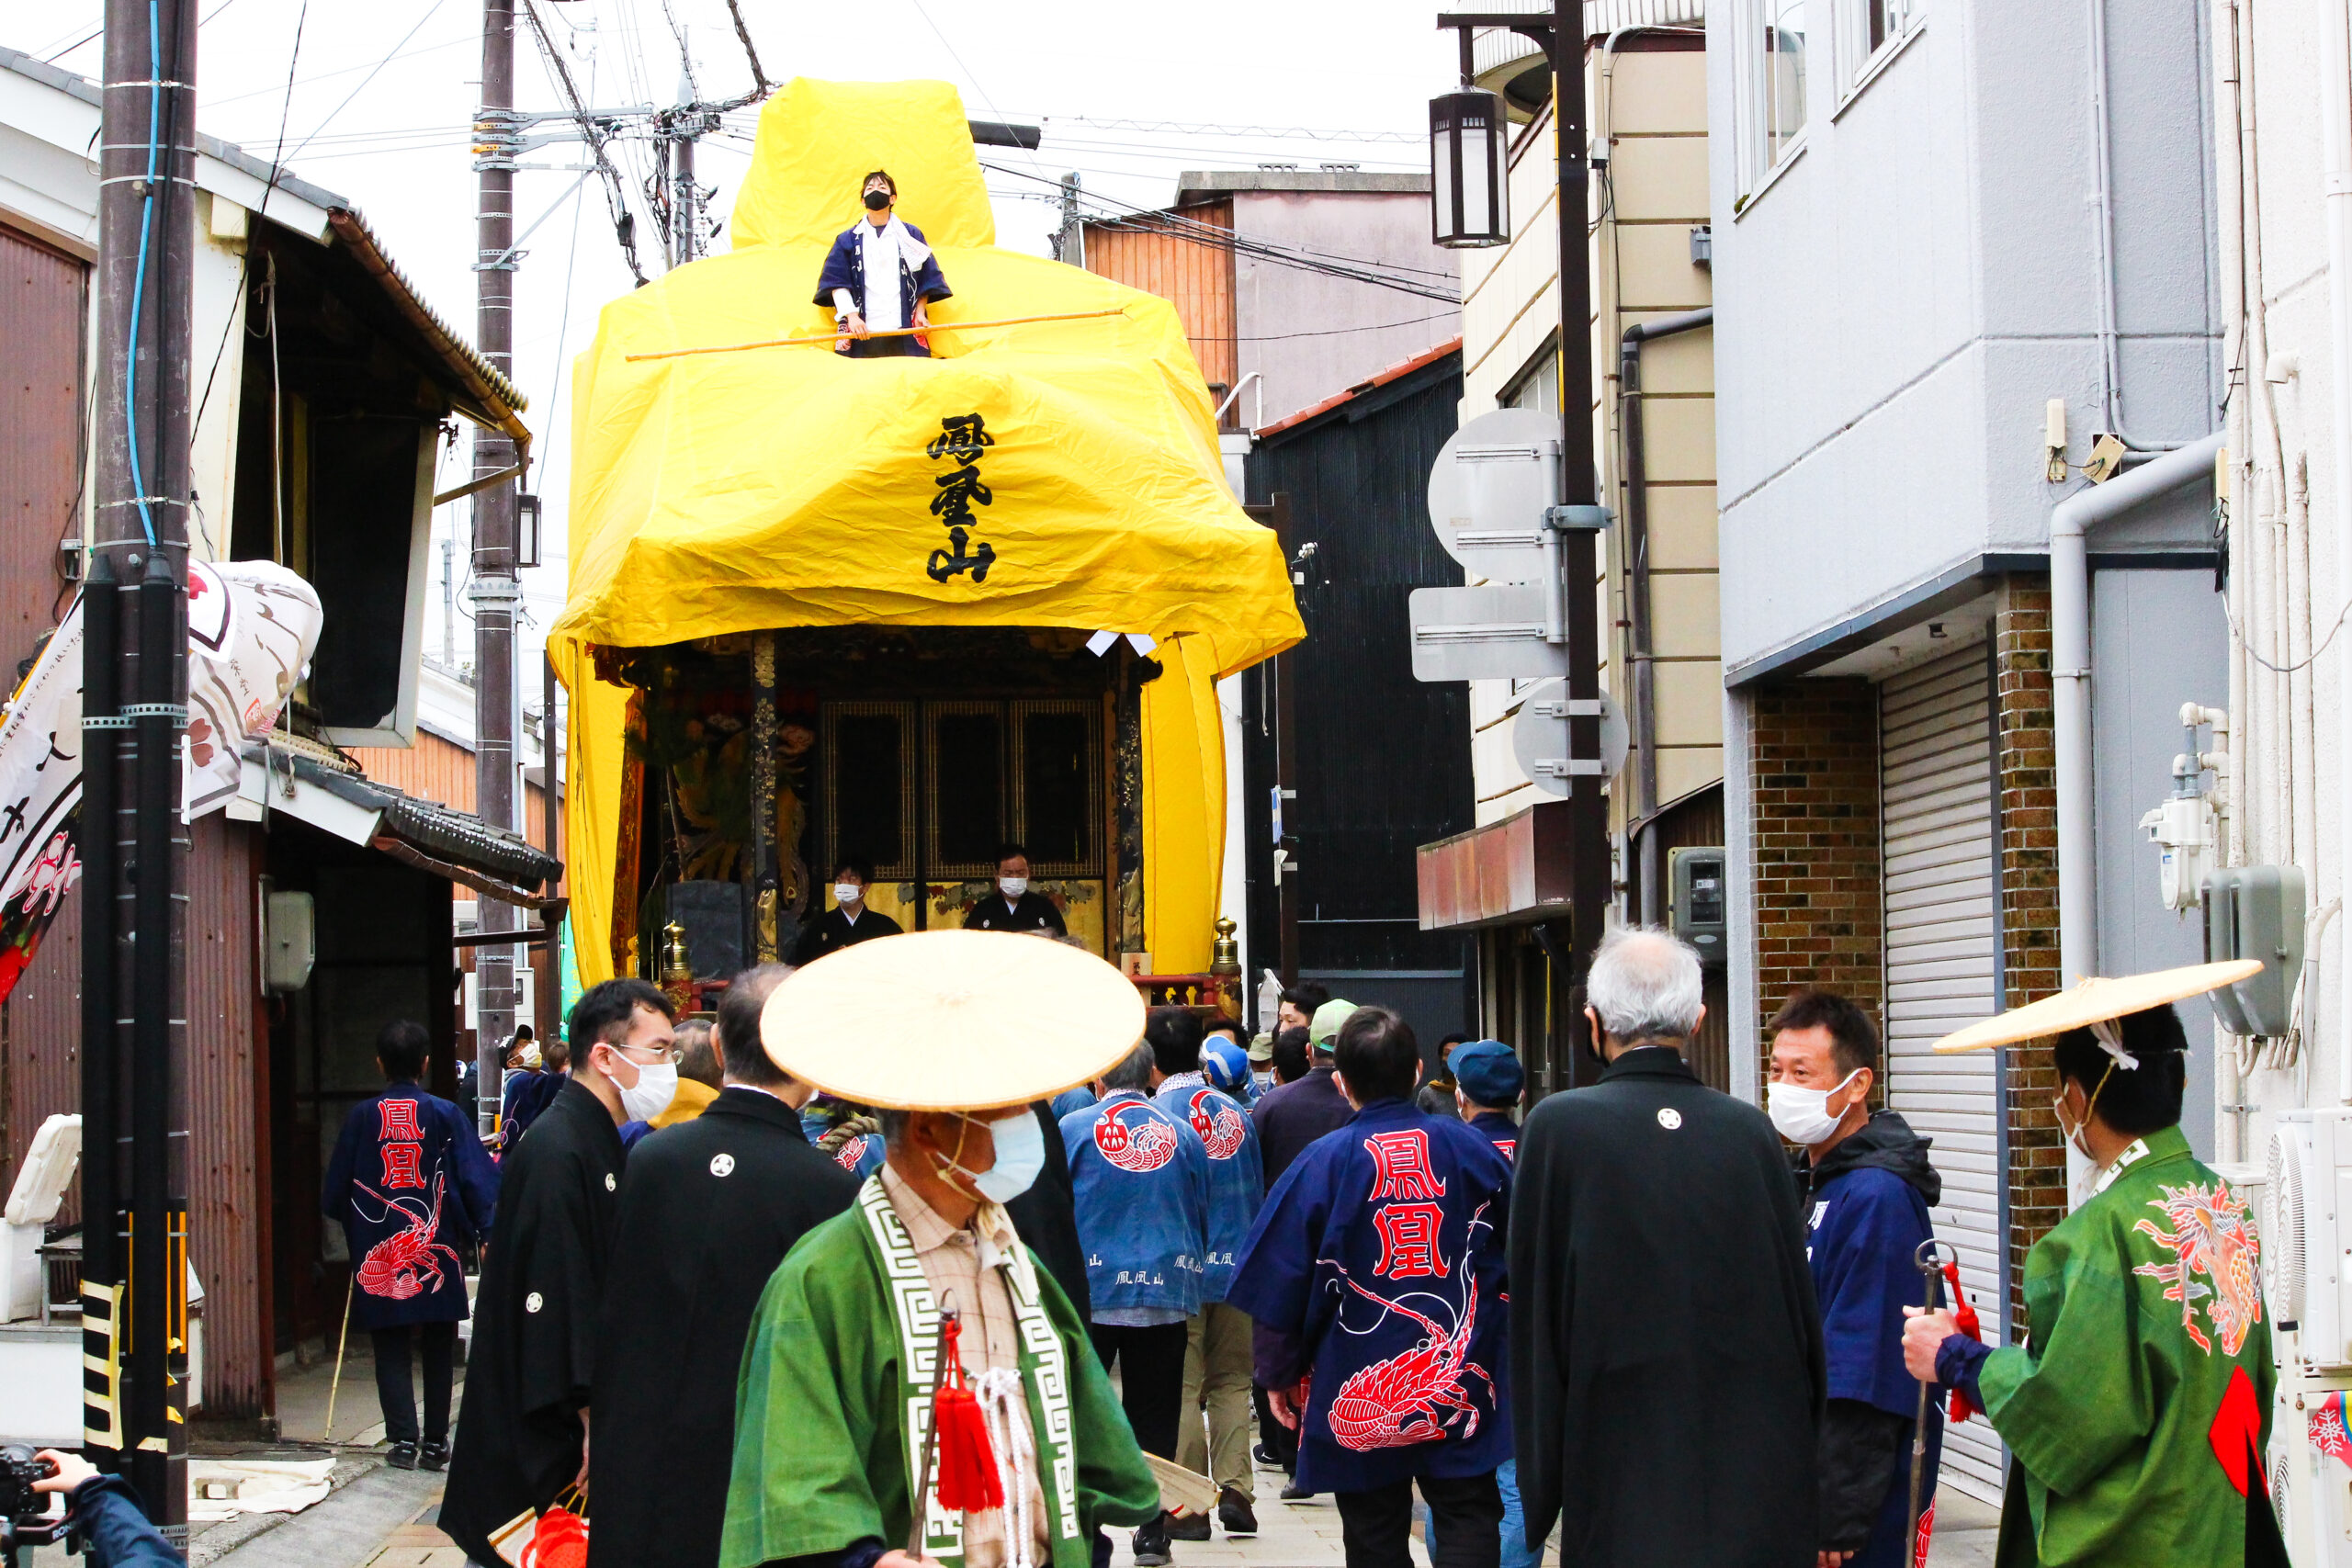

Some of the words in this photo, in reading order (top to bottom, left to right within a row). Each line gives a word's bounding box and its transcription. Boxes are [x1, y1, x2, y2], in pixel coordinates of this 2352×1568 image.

[926, 412, 997, 584] 鳳凰山
[378, 1098, 427, 1190] 鳳凰
[1363, 1128, 1451, 1280] 鳳凰
[1089, 1253, 1102, 1267] 山
